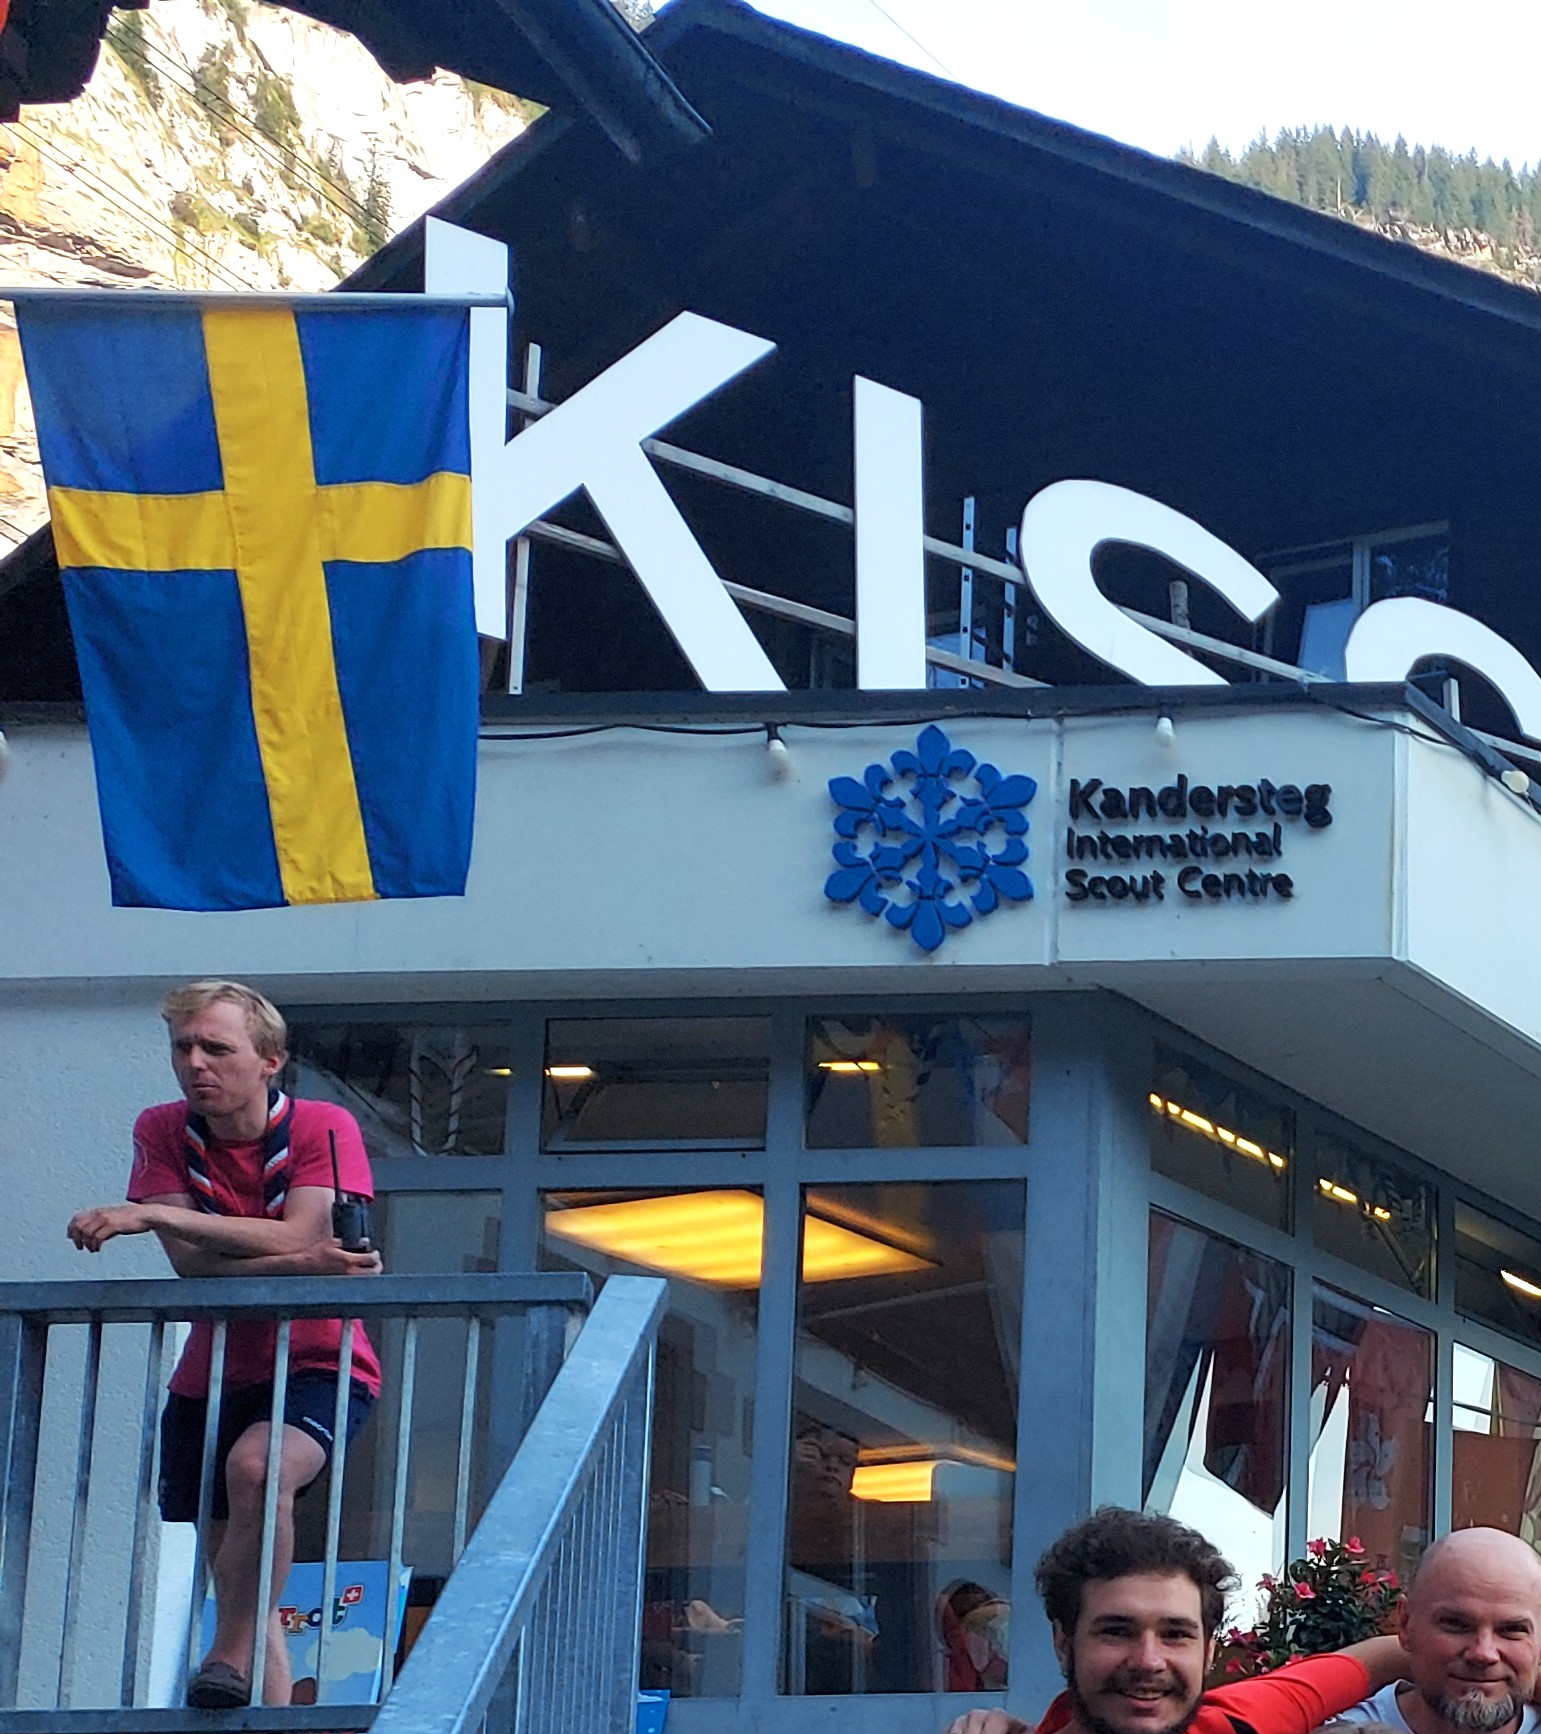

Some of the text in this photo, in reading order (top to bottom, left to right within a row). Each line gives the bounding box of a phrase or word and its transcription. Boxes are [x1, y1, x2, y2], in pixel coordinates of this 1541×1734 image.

[1069, 774, 1333, 828] Kandersteg
[1066, 821, 1283, 860] International
[1065, 866, 1294, 900] Scout Centre
